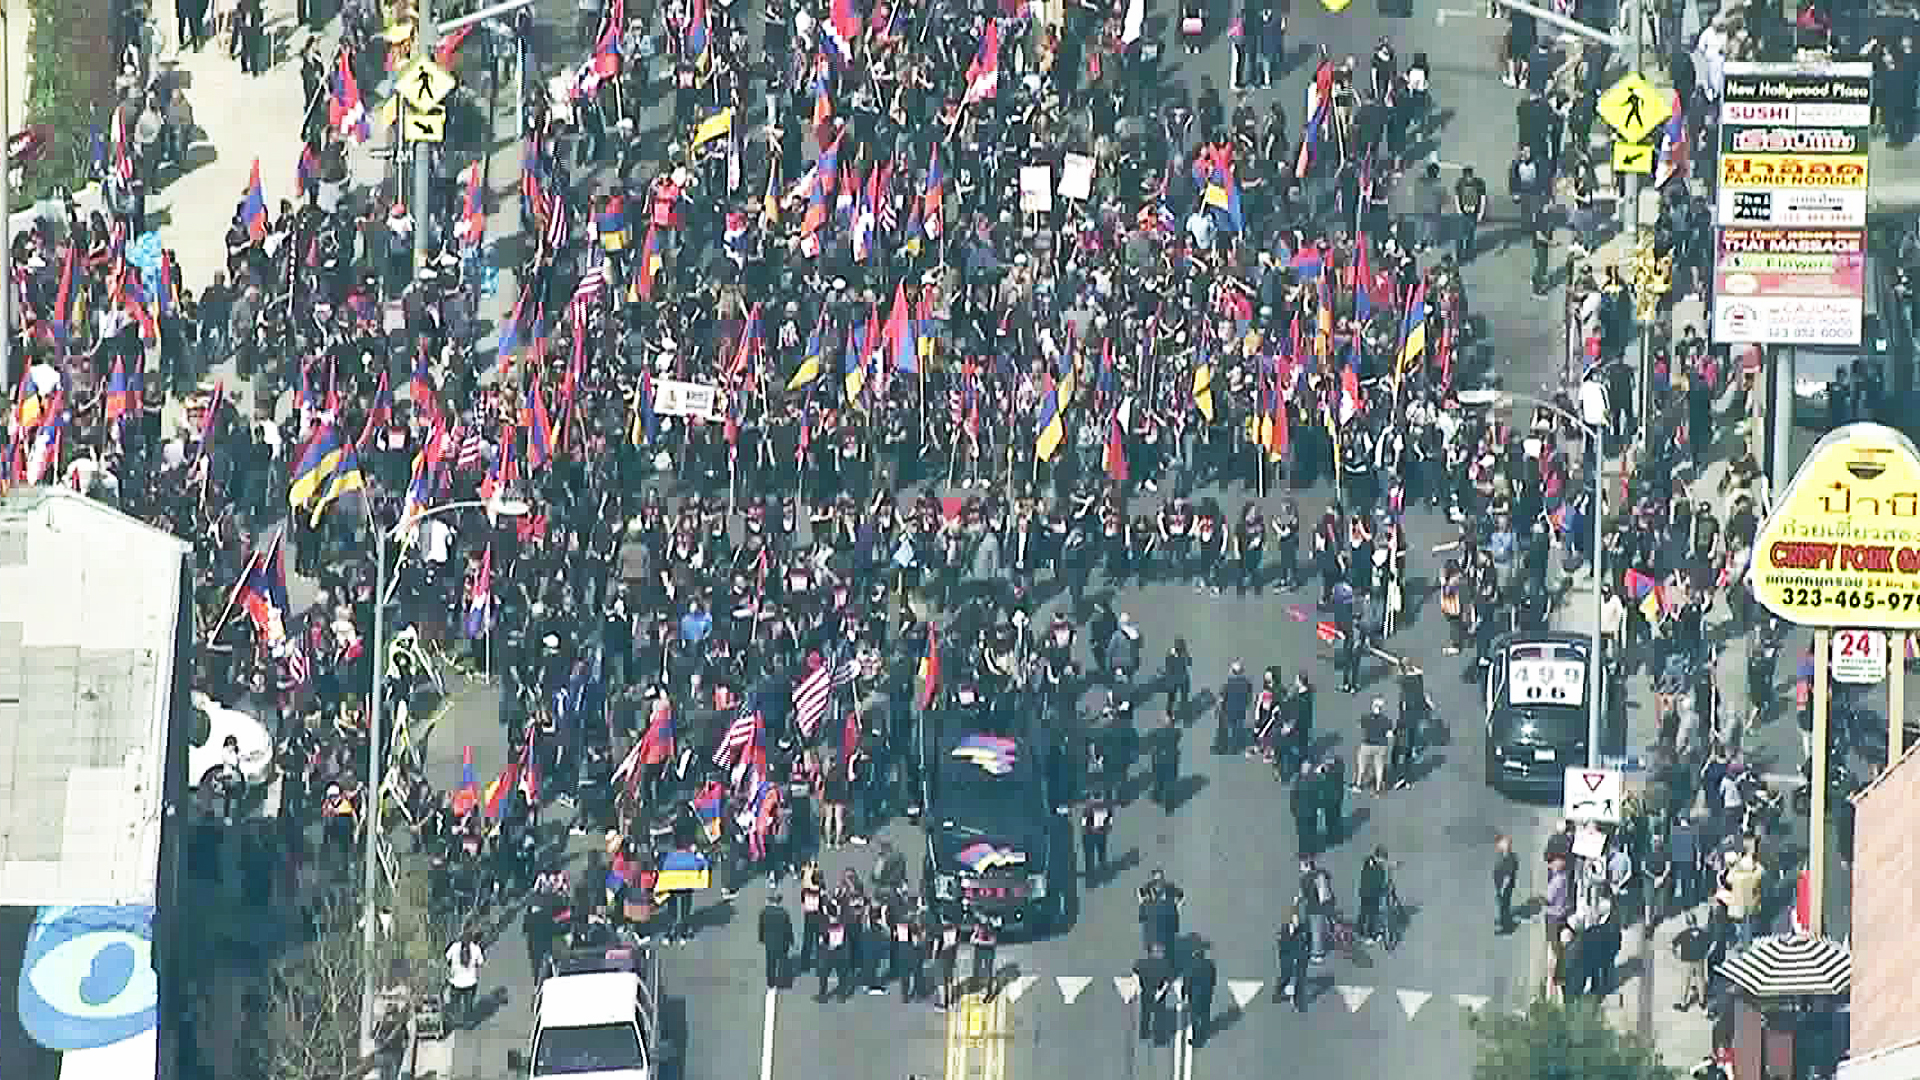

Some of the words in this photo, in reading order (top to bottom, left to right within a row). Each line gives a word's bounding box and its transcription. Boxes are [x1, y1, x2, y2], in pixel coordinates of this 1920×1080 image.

[1727, 80, 1756, 96] New
[1760, 79, 1829, 99] Hollywood
[1832, 80, 1868, 97] Plaza
[1729, 106, 1790, 120] SUSHI
[1791, 175, 1861, 186] NOODLE
[1725, 239, 1764, 250] THAI
[1769, 541, 1838, 570] CRISPY
[1840, 544, 1895, 573] PORK
[1840, 631, 1870, 658] 24
